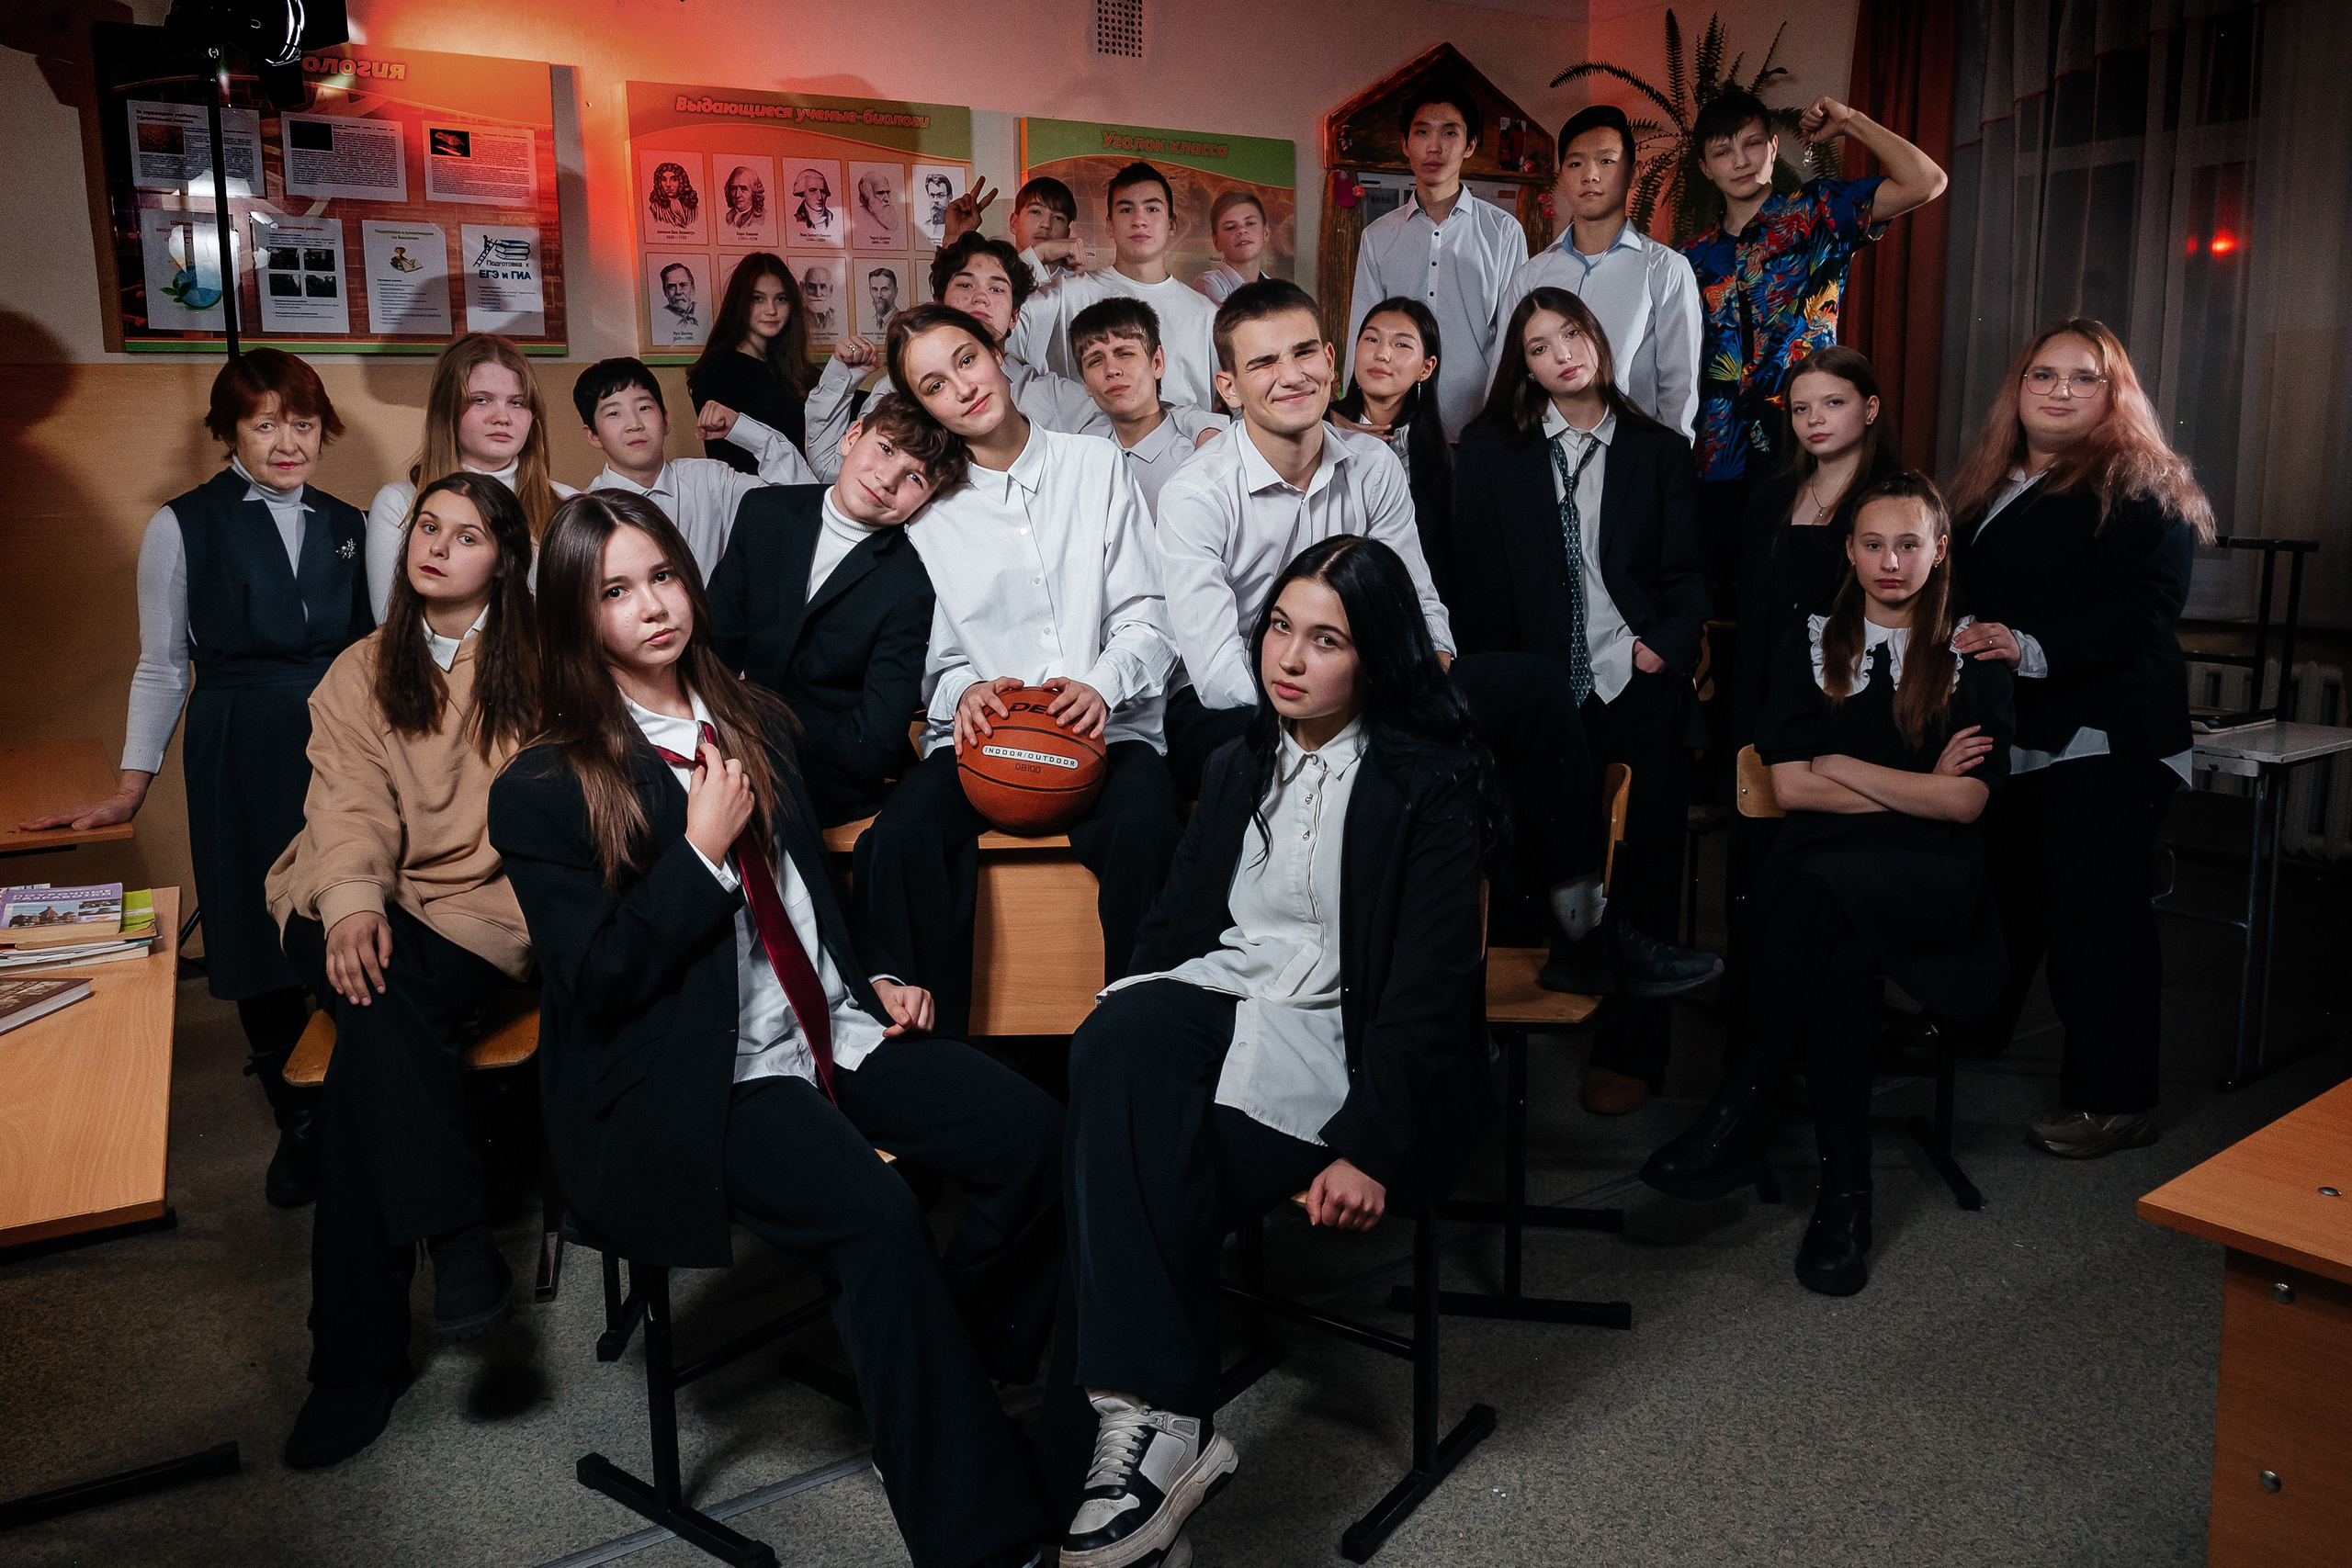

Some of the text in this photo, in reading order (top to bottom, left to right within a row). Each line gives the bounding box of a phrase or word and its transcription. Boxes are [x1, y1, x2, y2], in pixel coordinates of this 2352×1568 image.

[301, 56, 405, 80] ология
[675, 96, 930, 128] Выдающиеся ученые-биологи
[1102, 131, 1228, 157] Уголок класса
[479, 269, 500, 279] ЕГЭ
[511, 270, 532, 280] ГИА
[486, 260, 523, 268] Подготовка
[984, 747, 1075, 767] INDOOR/OUTDOOR
